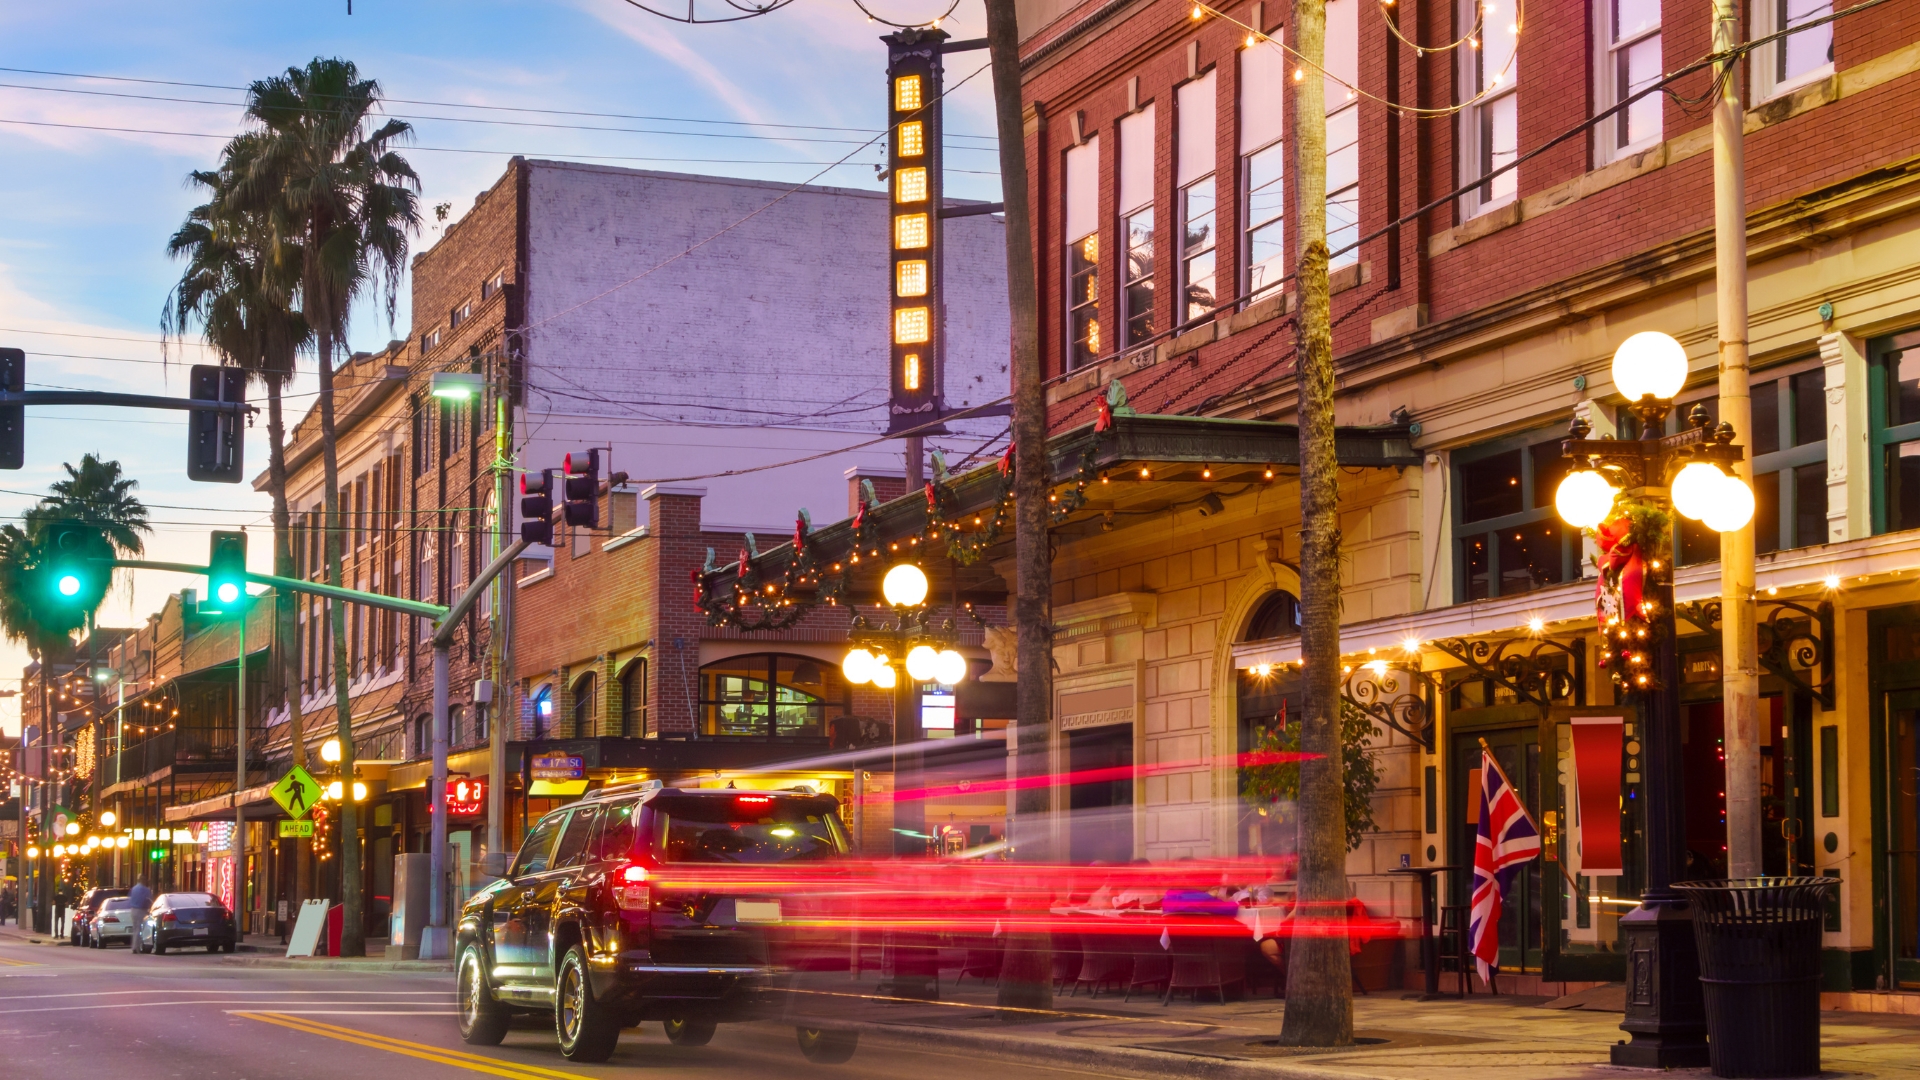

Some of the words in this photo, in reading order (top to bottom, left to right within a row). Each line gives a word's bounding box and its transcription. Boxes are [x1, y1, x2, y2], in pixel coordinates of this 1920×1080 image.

[1692, 661, 1710, 673] DARTS
[569, 758, 579, 767] St
[284, 824, 310, 833] AHEAD
